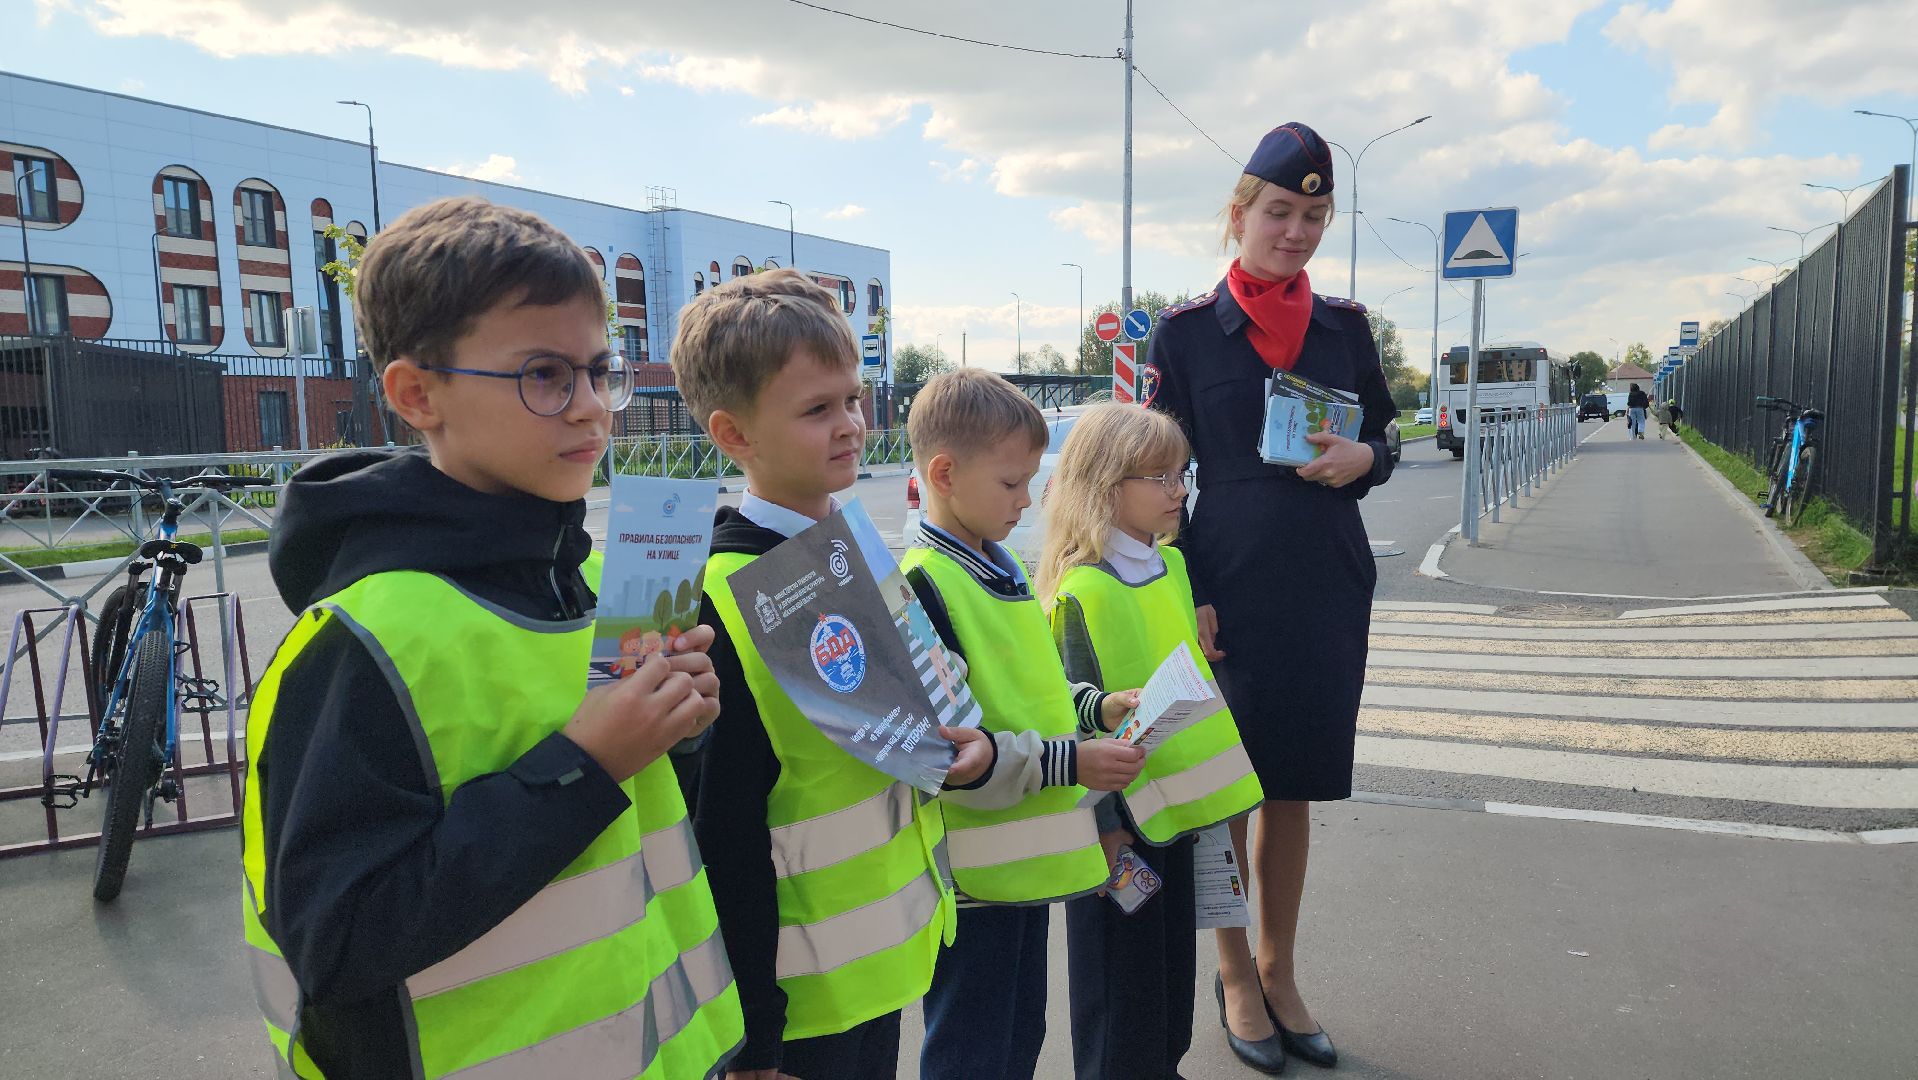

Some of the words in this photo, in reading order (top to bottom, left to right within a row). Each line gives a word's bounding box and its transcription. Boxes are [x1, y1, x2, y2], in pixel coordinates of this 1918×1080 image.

[619, 533, 654, 544] ПРАВИЛА
[655, 534, 703, 545] БЕЗОПАСНОСТИ
[646, 550, 656, 560] НА
[658, 550, 680, 561] УЛИЦЕ
[815, 627, 857, 667] БДД
[901, 715, 932, 754] ПОТЕРЯН!
